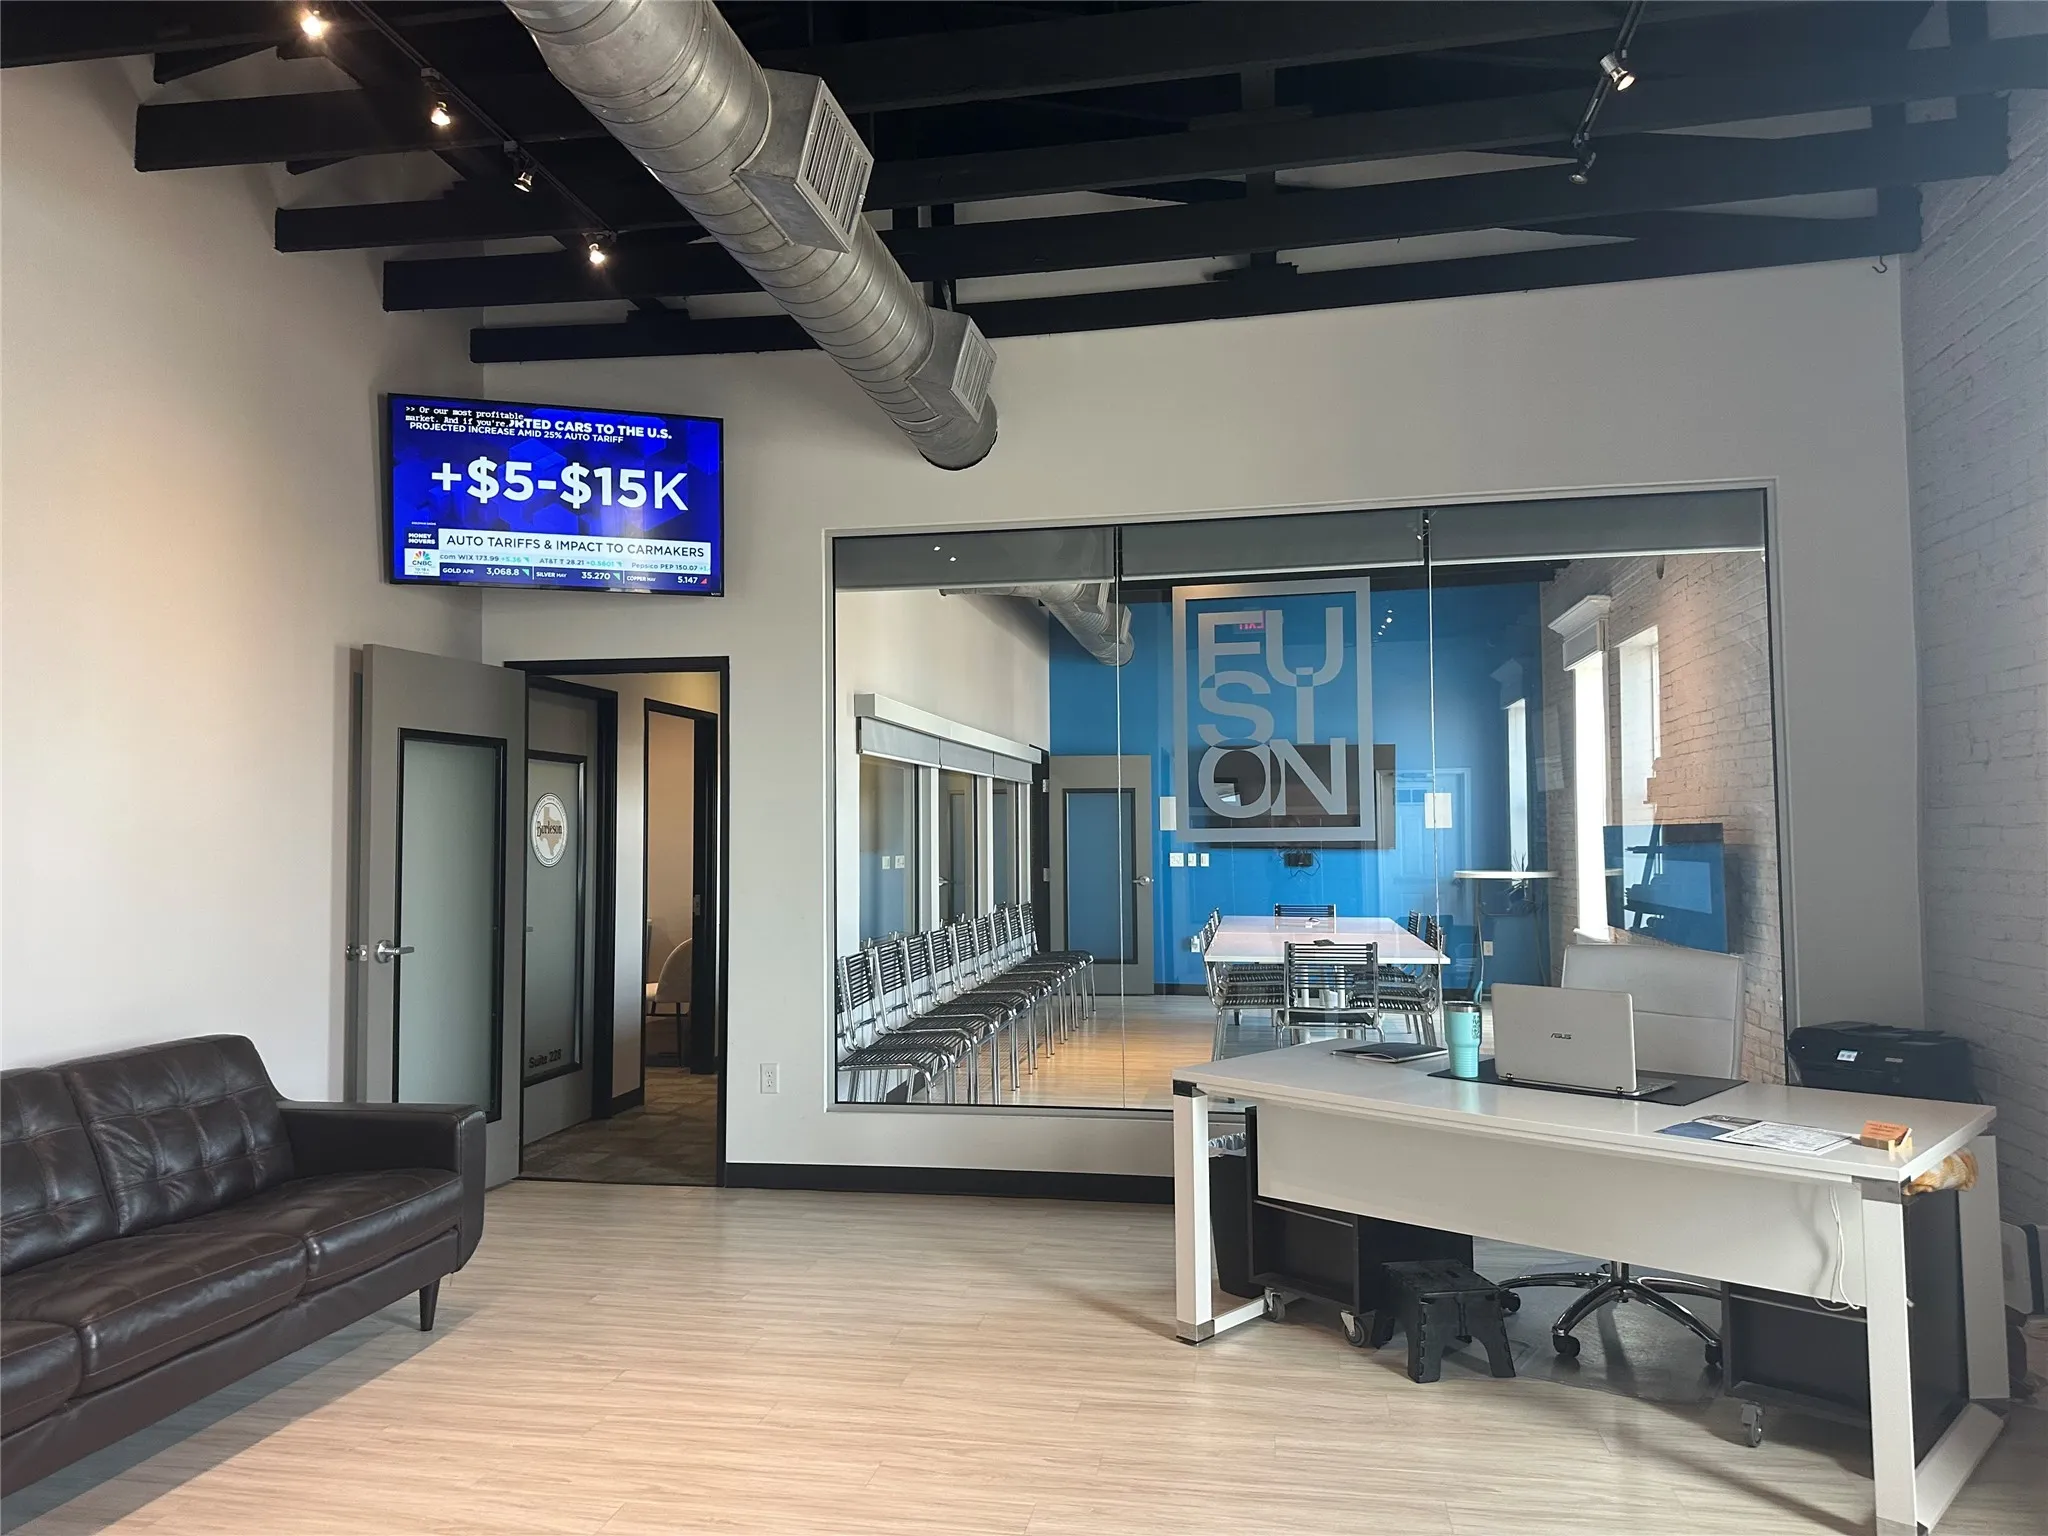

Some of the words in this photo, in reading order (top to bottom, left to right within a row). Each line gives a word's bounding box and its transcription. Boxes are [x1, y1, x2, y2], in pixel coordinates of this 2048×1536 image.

[405, 415, 439, 423] market.
[419, 406, 430, 414] Or
[476, 410, 524, 420] profitable
[409, 422, 466, 433] PROJECTED
[468, 426, 515, 436] INCREASE
[517, 429, 541, 438] AMID
[544, 431, 562, 439] 25%
[564, 432, 590, 441] AUTO
[592, 434, 624, 443] TARIFF
[554, 421, 592, 433] CARS
[595, 423, 614, 435] TO
[617, 425, 644, 437] THE
[647, 427, 672, 439] U.S.
[431, 456, 689, 511] +$5-$15K
[446, 535, 484, 547] AUTO
[487, 537, 540, 549] TARIFFS
[544, 540, 552, 550] &
[556, 540, 603, 553] IMPACT
[606, 543, 623, 553] TO
[627, 544, 704, 557] CARMAKERS
[486, 567, 520, 576] 3,068.8
[581, 572, 610, 580] 35.270
[677, 576, 698, 584] 5.147
[537, 821, 562, 837] Burleson
